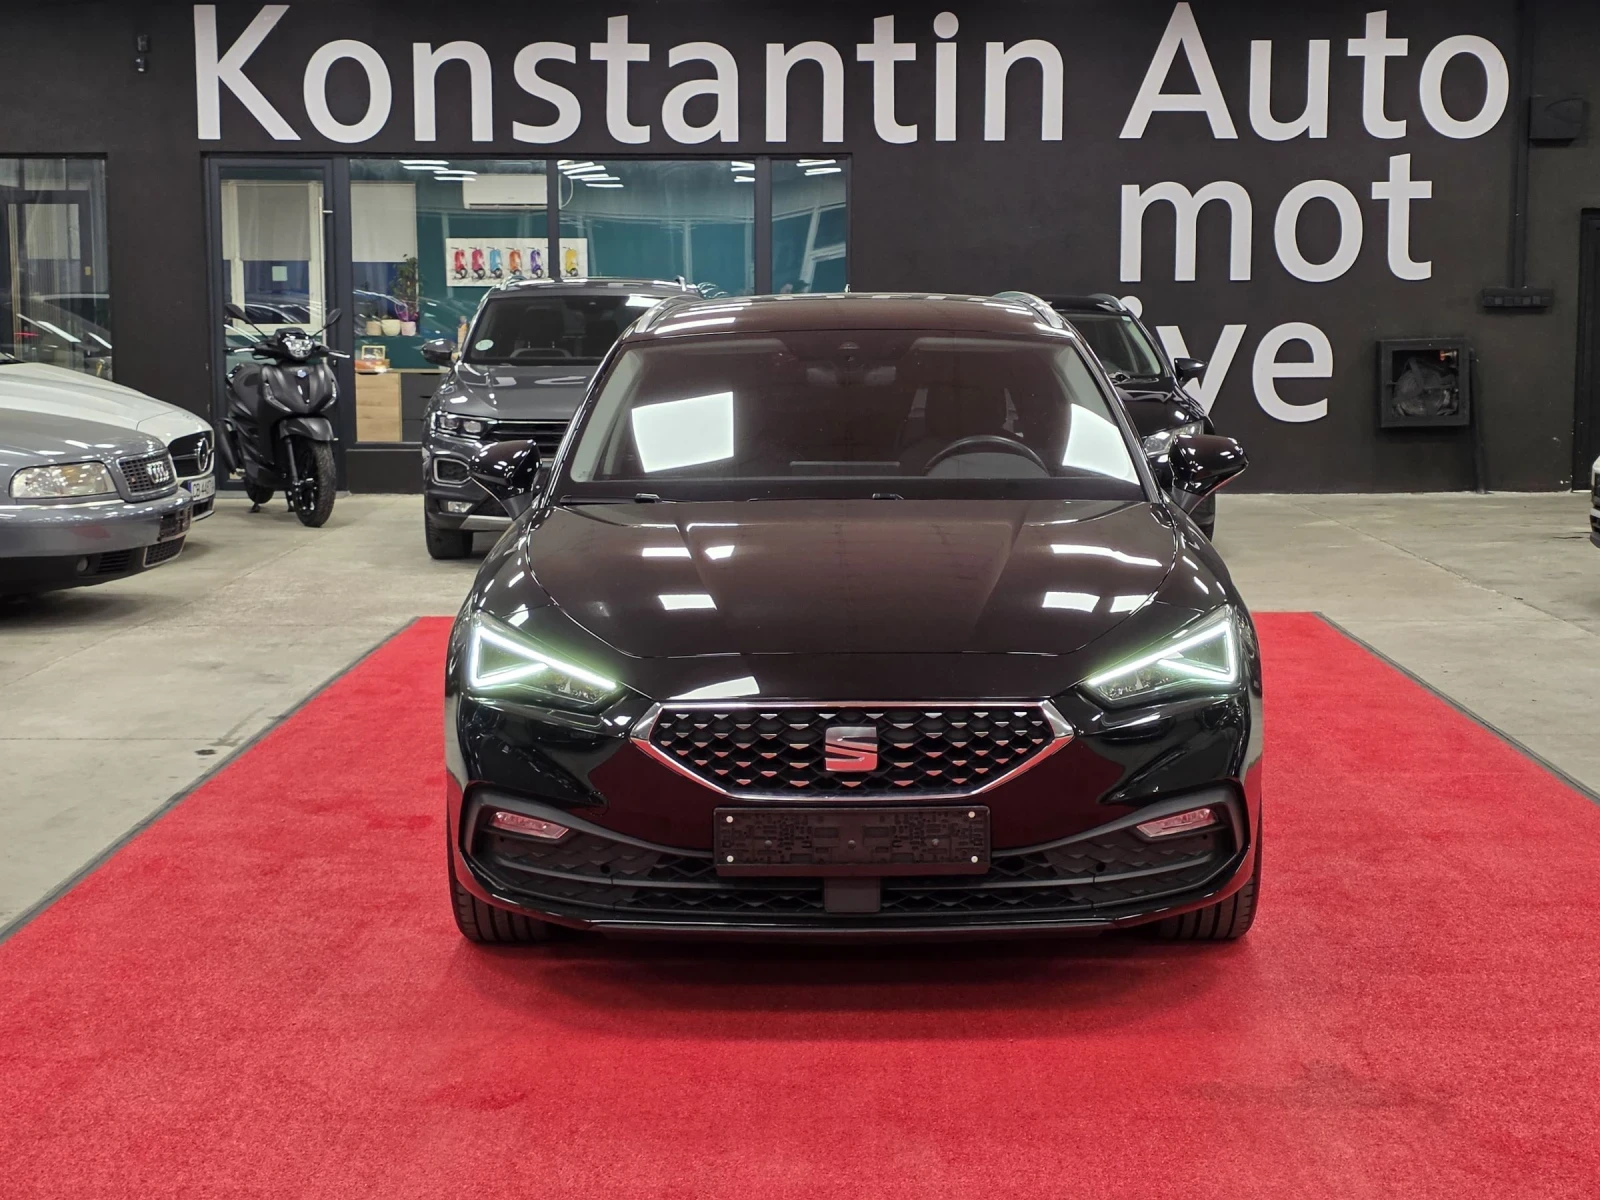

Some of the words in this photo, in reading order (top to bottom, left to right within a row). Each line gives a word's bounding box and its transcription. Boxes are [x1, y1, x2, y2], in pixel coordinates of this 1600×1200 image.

[194, 4, 1064, 145] Konstantin
[1119, 2, 1510, 141] Auto
[1120, 153, 1432, 283] mot
[1118, 296, 1334, 423] ve
